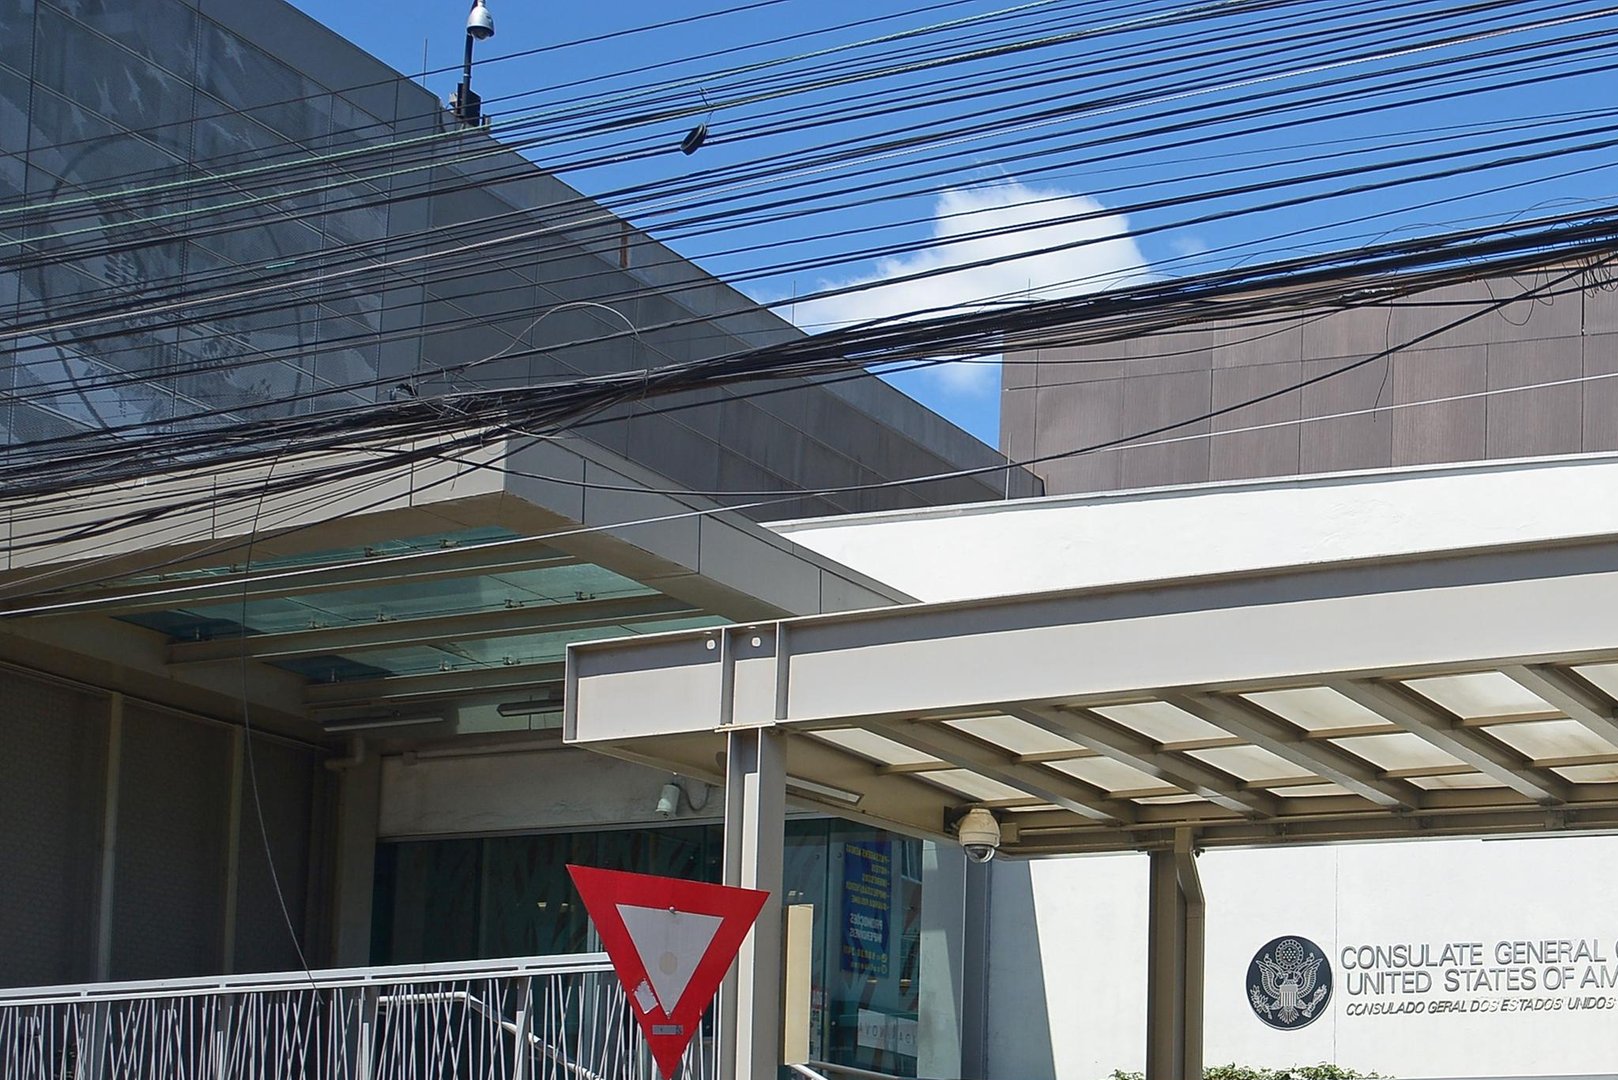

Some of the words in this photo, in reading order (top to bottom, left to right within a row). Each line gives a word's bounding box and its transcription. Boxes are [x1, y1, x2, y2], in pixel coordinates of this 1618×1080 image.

[1341, 943, 1483, 970] CONSULATE
[1495, 939, 1606, 965] GENERAL
[1347, 970, 1432, 995] UNITED
[1444, 966, 1537, 992] STATES
[1543, 966, 1575, 990] OF
[1346, 1001, 1425, 1016] CONSULADO
[1428, 1000, 1467, 1014] GERAL
[1470, 999, 1499, 1013] DOS
[1500, 998, 1563, 1012] ESTADOS
[1567, 996, 1615, 1010] UNIDOS
